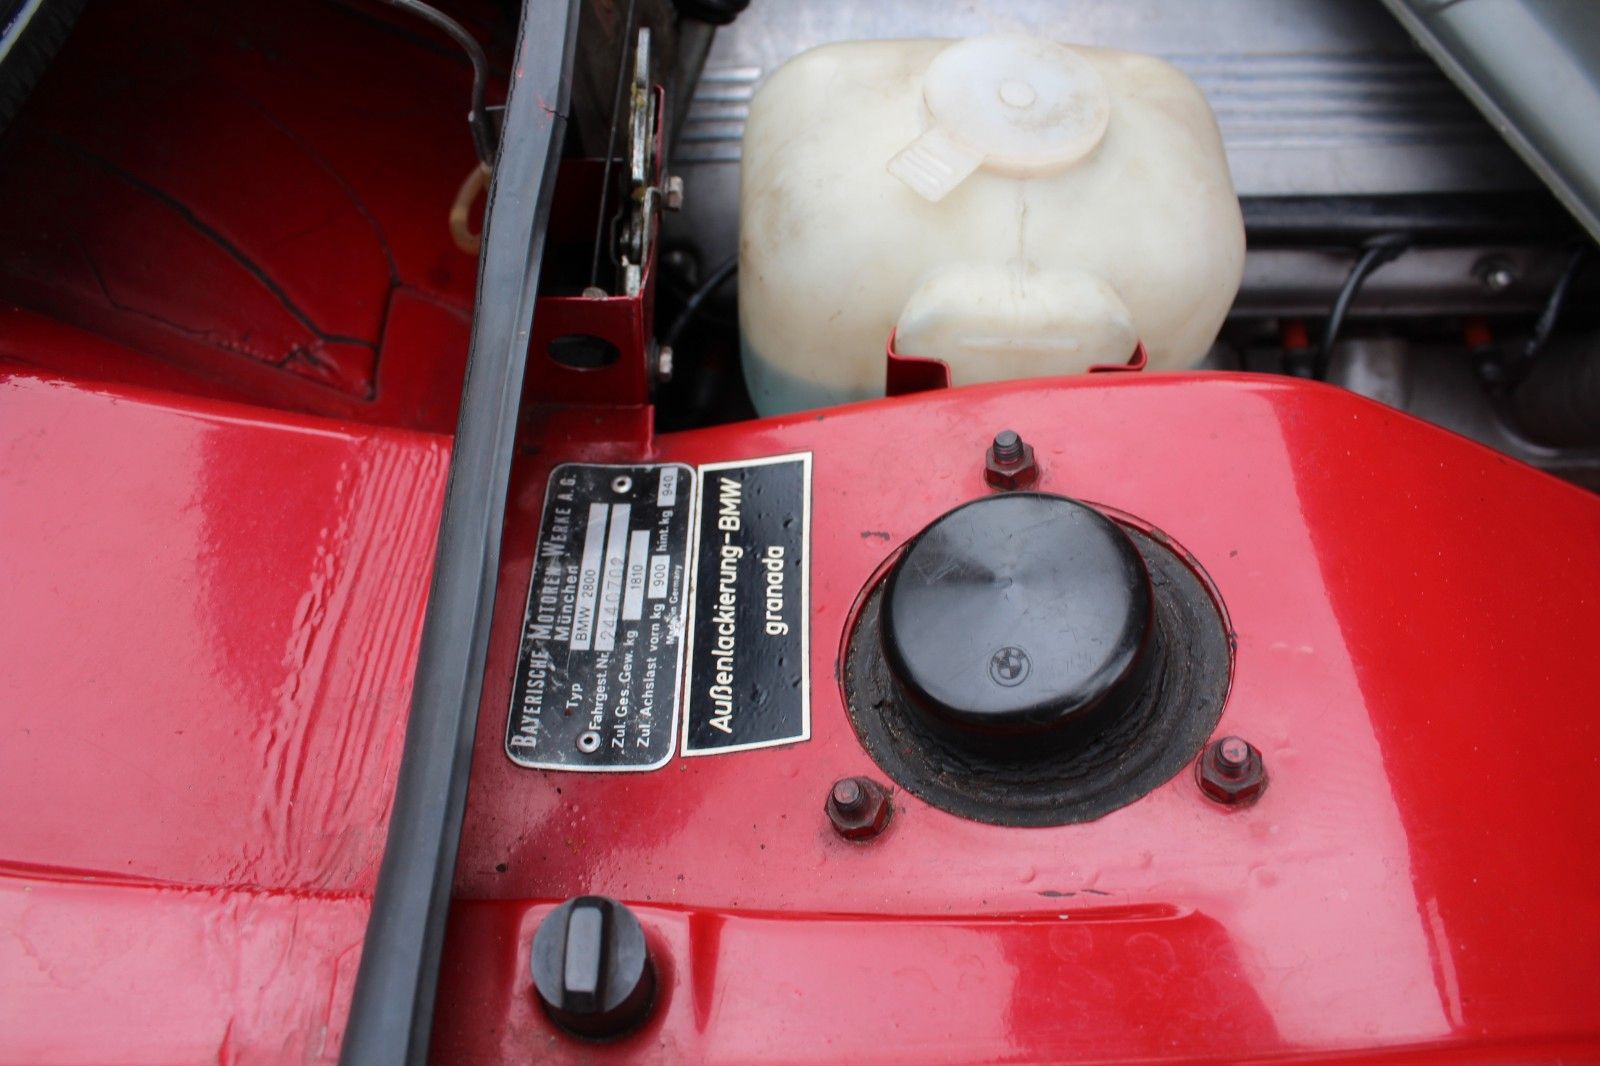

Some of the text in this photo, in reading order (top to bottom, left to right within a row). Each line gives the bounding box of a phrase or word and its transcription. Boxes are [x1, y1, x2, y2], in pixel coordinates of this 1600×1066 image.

[661, 475, 674, 497] 940
[541, 507, 572, 558] WERKE
[630, 564, 644, 590] 1810
[652, 563, 666, 587] 900
[669, 564, 683, 604] Germany
[761, 545, 789, 636] granada
[527, 566, 562, 640] MOTOREN
[554, 565, 579, 641] München
[650, 603, 666, 619] kg
[709, 477, 744, 734] Außenlackierung-BMW
[566, 569, 596, 708] Typ BMW 2800
[623, 630, 639, 647] kg
[650, 623, 661, 653] vorn
[511, 651, 549, 749] BAYERISCHE
[640, 657, 658, 717] Achslast
[611, 721, 626, 749] Zul.
[636, 720, 651, 749] Zul.
